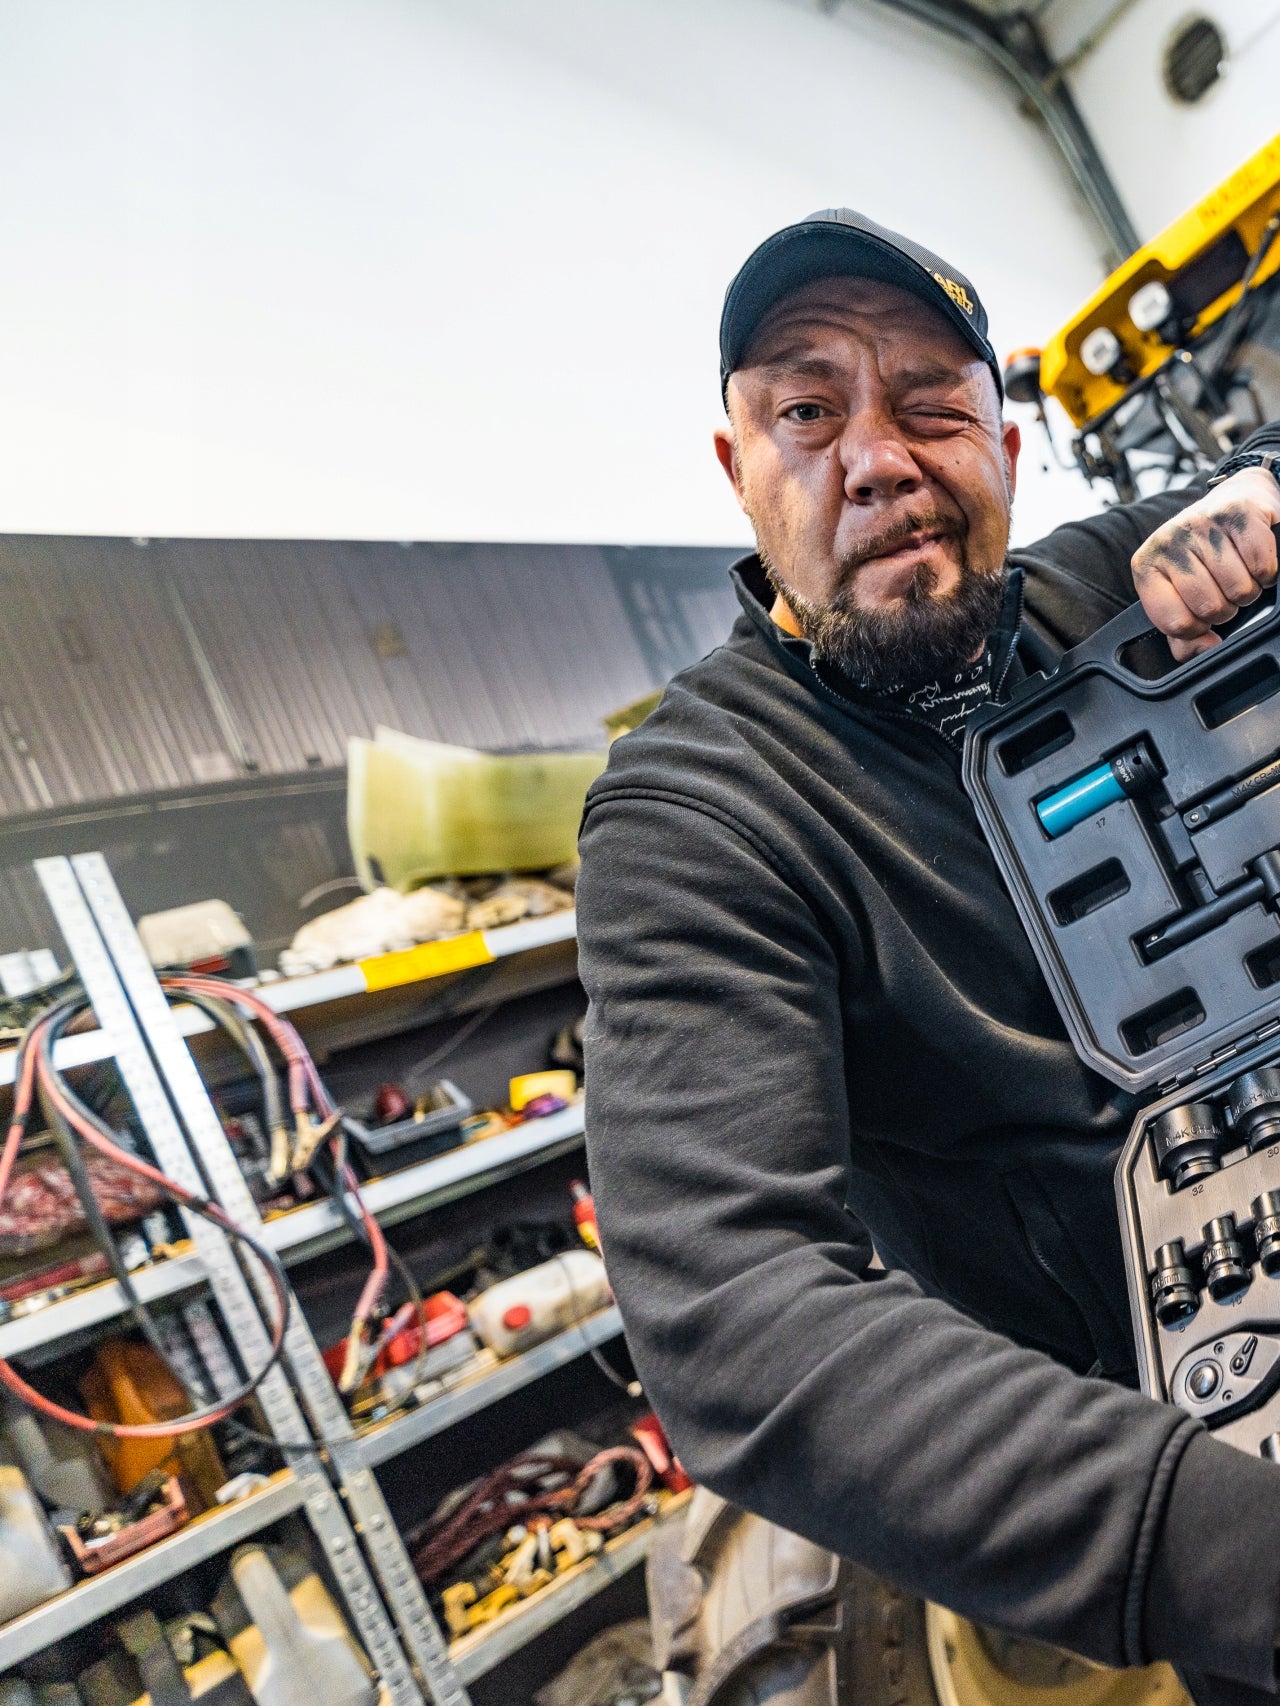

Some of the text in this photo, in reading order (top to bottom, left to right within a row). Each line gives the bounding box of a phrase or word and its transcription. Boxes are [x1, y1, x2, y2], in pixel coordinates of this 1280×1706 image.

[1096, 816, 1106, 828] 17
[1267, 1146, 1280, 1158] 30
[1191, 1184, 1205, 1197] 32
